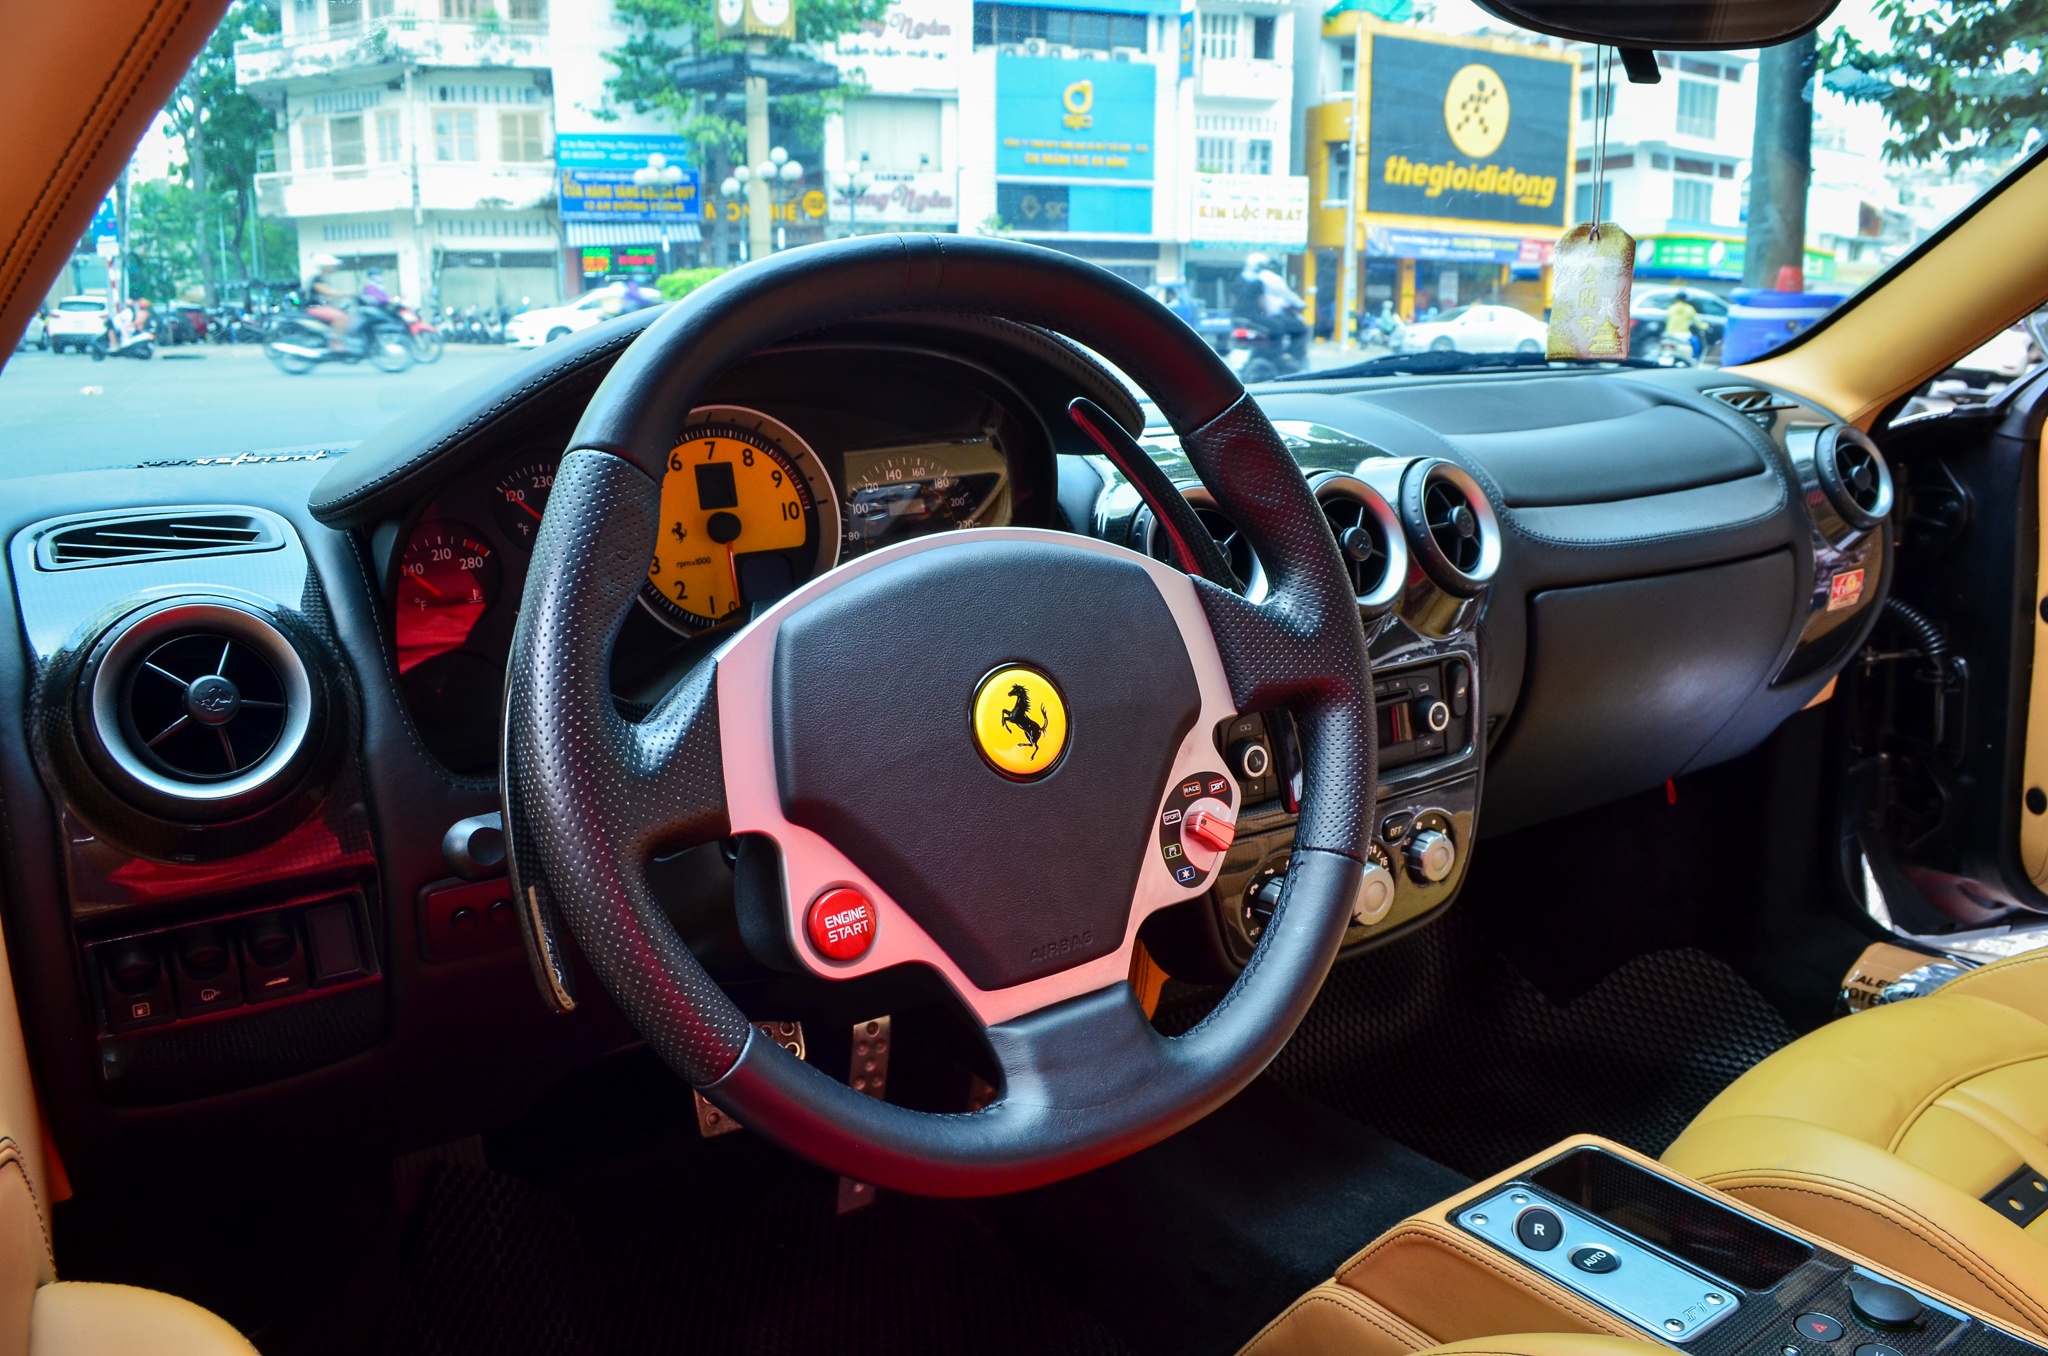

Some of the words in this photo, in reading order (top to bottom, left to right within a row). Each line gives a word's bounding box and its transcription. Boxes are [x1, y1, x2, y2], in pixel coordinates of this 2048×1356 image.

[1384, 155, 1557, 207] thegioididong
[1199, 206, 1226, 218] KIM
[704, 441, 716, 460] 7
[742, 448, 755, 467] 8
[670, 453, 683, 471] 6
[771, 470, 783, 488] 9
[885, 469, 902, 480] 140
[912, 467, 926, 477] 160
[532, 476, 554, 488] 230
[865, 482, 879, 492] 120
[934, 478, 949, 489] 180
[852, 503, 869, 515] 100
[951, 497, 966, 507] 200
[781, 501, 800, 521] 10
[848, 531, 860, 541] 80
[431, 548, 452, 561] 210
[459, 556, 484, 570] 280
[650, 555, 661, 575] 3
[674, 581, 688, 600] 2
[1390, 825, 1403, 837] OFF
[824, 905, 867, 929] ENGINE
[828, 919, 869, 943] START
[1030, 930, 1094, 961] AIRBAG
[1533, 1222, 1545, 1236] R
[1583, 1251, 1607, 1267] AUTO
